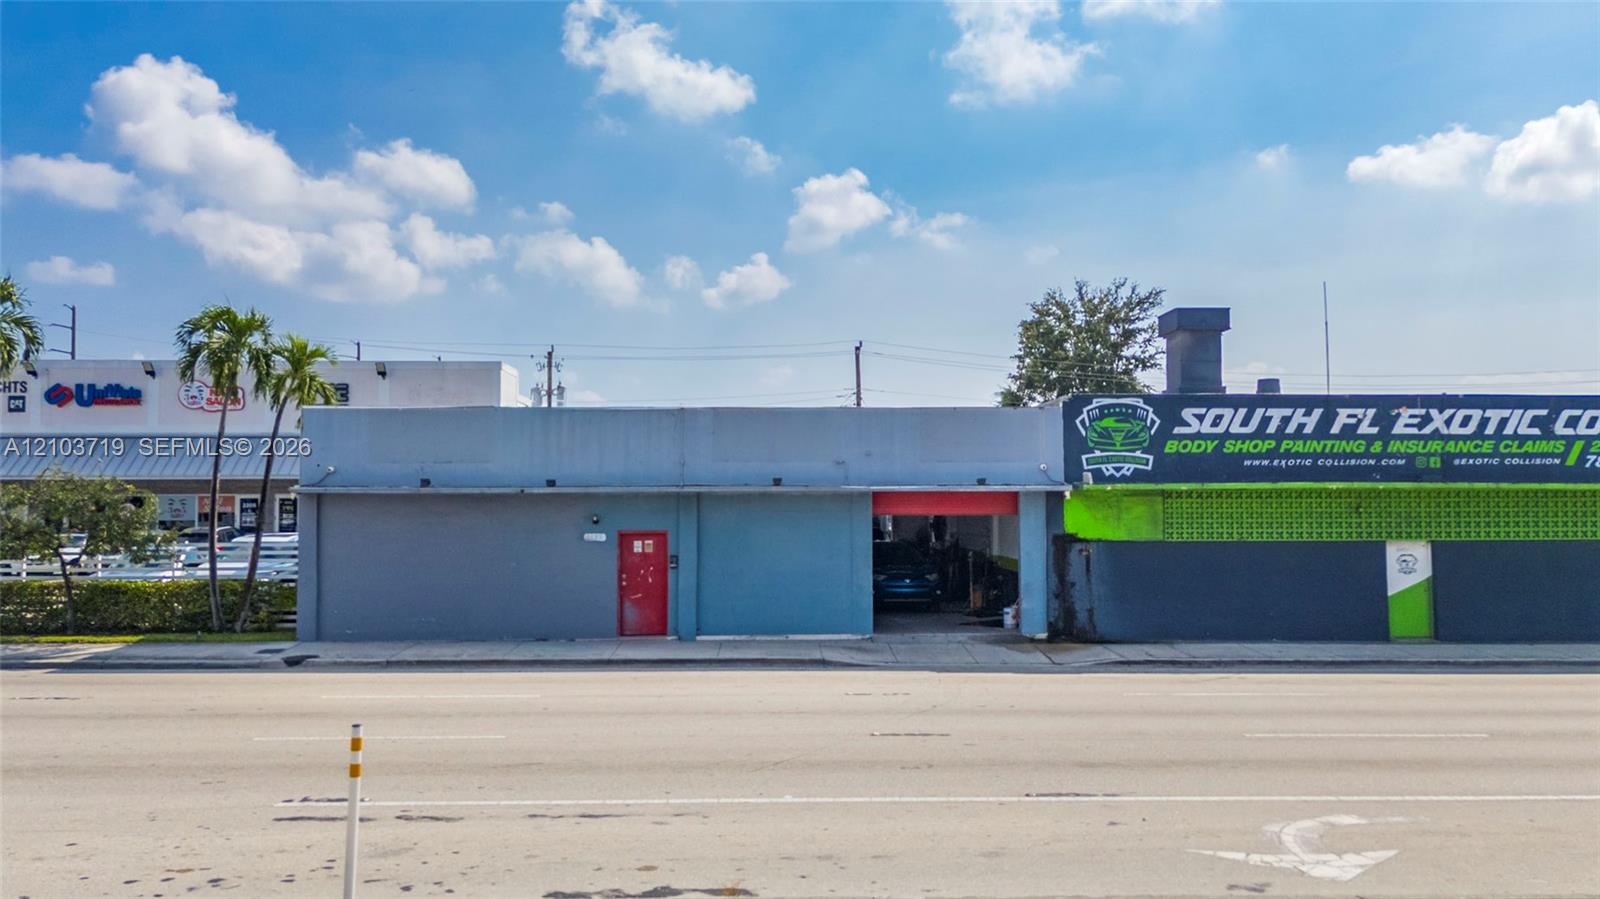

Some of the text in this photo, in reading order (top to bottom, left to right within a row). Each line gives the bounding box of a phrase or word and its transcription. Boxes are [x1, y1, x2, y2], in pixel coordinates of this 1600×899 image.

[1172, 408, 1600, 435] SOUTH FL EXOTIC CO
[1164, 439, 1566, 454] BODY SHOP PAINTING & INSURANCE CLAIMS
[1504, 457, 1561, 466] COLLISION
